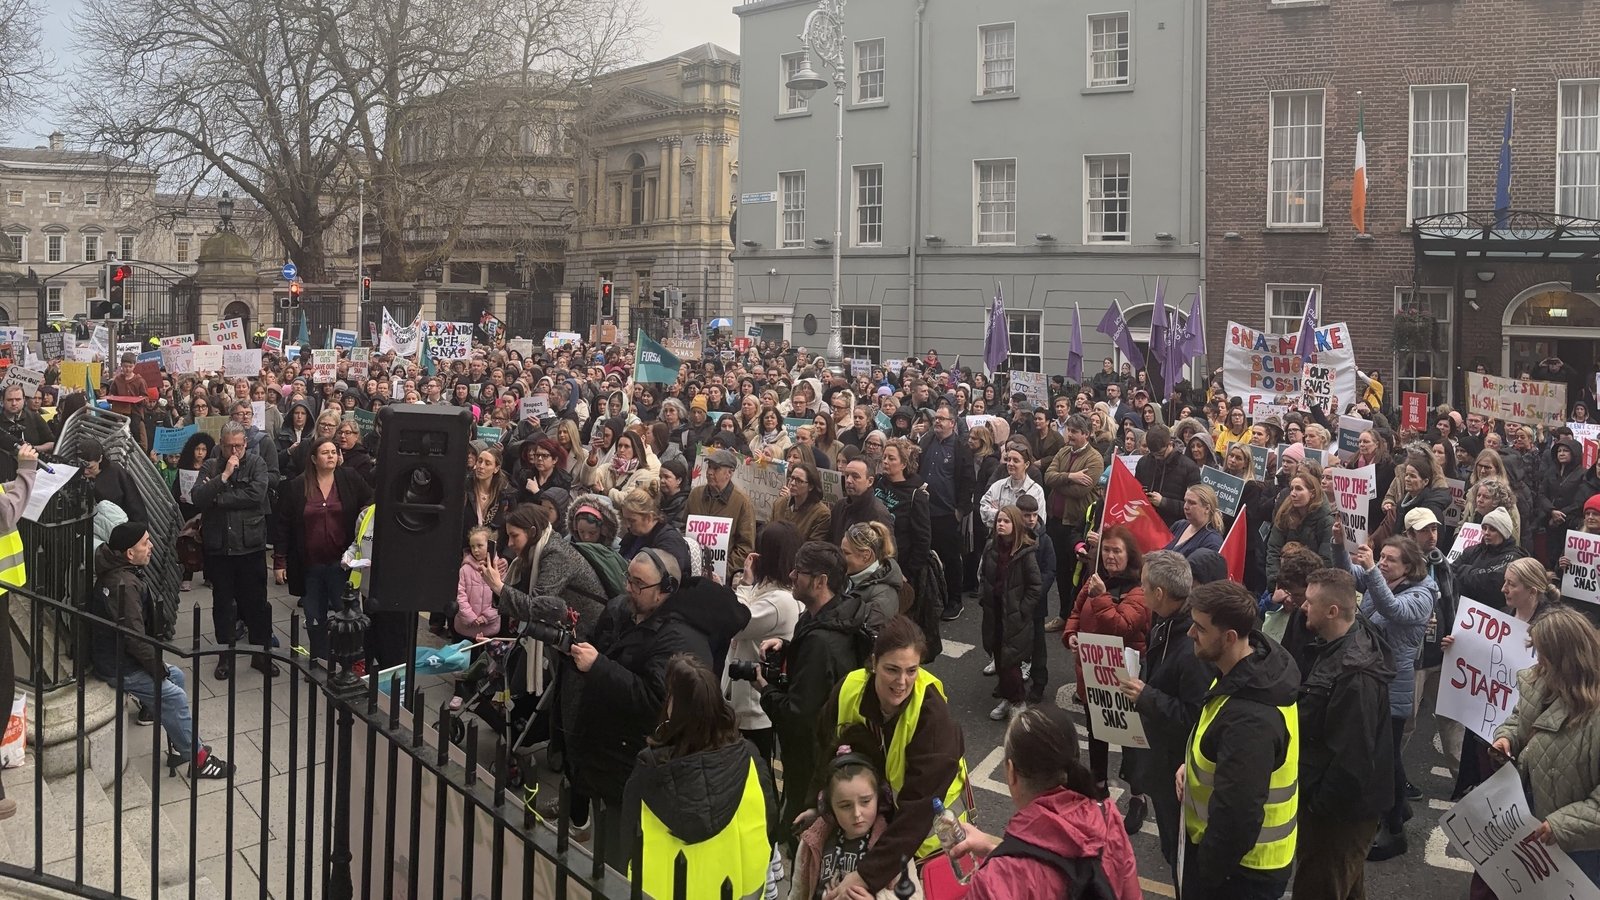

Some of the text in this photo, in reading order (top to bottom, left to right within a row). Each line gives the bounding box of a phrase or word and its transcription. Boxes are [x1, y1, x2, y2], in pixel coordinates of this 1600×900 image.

[213, 320, 238, 331] SAVE
[176, 336, 192, 344] SNA
[217, 332, 238, 341] OUR
[437, 336, 458, 346] OFF
[671, 340, 696, 348] SUPPORT
[1279, 327, 1344, 355] MKE
[1310, 366, 1330, 381] OUR
[1482, 376, 1557, 398] Respect SNAs!
[1472, 394, 1481, 408] No
[1483, 396, 1500, 412] SNA
[1513, 402, 1526, 417] No
[823, 471, 838, 484] CHILD
[1203, 476, 1239, 496] Our schools
[1334, 475, 1368, 495] STOP THE
[1219, 491, 1235, 503] SNAs
[1341, 492, 1357, 510] CUTS
[688, 520, 729, 533] STOP THE
[1350, 513, 1366, 531] OUR
[697, 533, 718, 546] CUTS
[1345, 526, 1357, 543] SNAS
[1460, 527, 1479, 540] STOP
[1568, 536, 1591, 551] STOP
[1577, 551, 1599, 565] CUT
[1574, 577, 1596, 592] SNAS
[1460, 607, 1512, 644] STOP
[1080, 643, 1125, 668] STOP THE
[1094, 665, 1120, 687] CUTS
[1451, 657, 1513, 711] START
[1087, 687, 1113, 709] FUND
[1102, 709, 1128, 730] SNAS
[1446, 798, 1526, 866] Education
[1512, 830, 1560, 884] NOT
